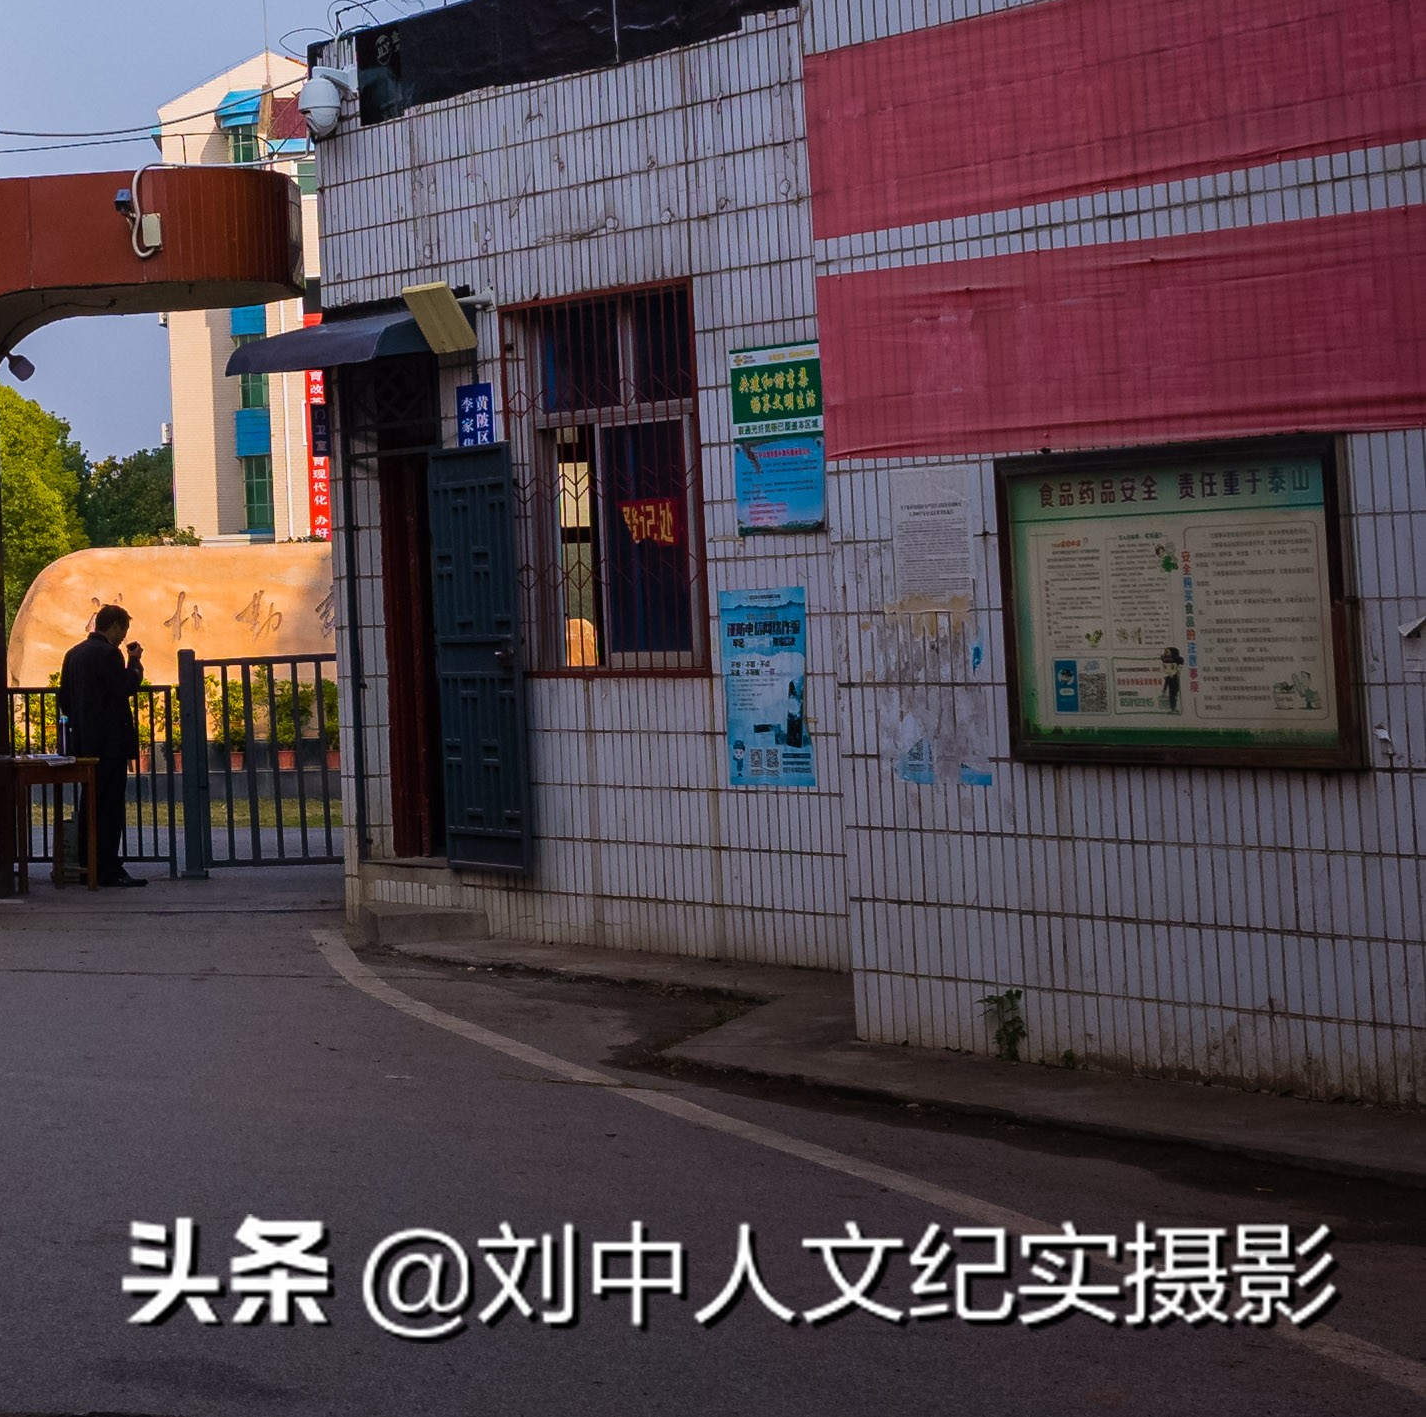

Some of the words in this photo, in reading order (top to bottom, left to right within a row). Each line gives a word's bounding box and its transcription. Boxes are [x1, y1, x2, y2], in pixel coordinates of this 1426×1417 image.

[1039, 474, 1159, 509] 食品药品安全
[1178, 465, 1311, 500] 责任重于泰山
